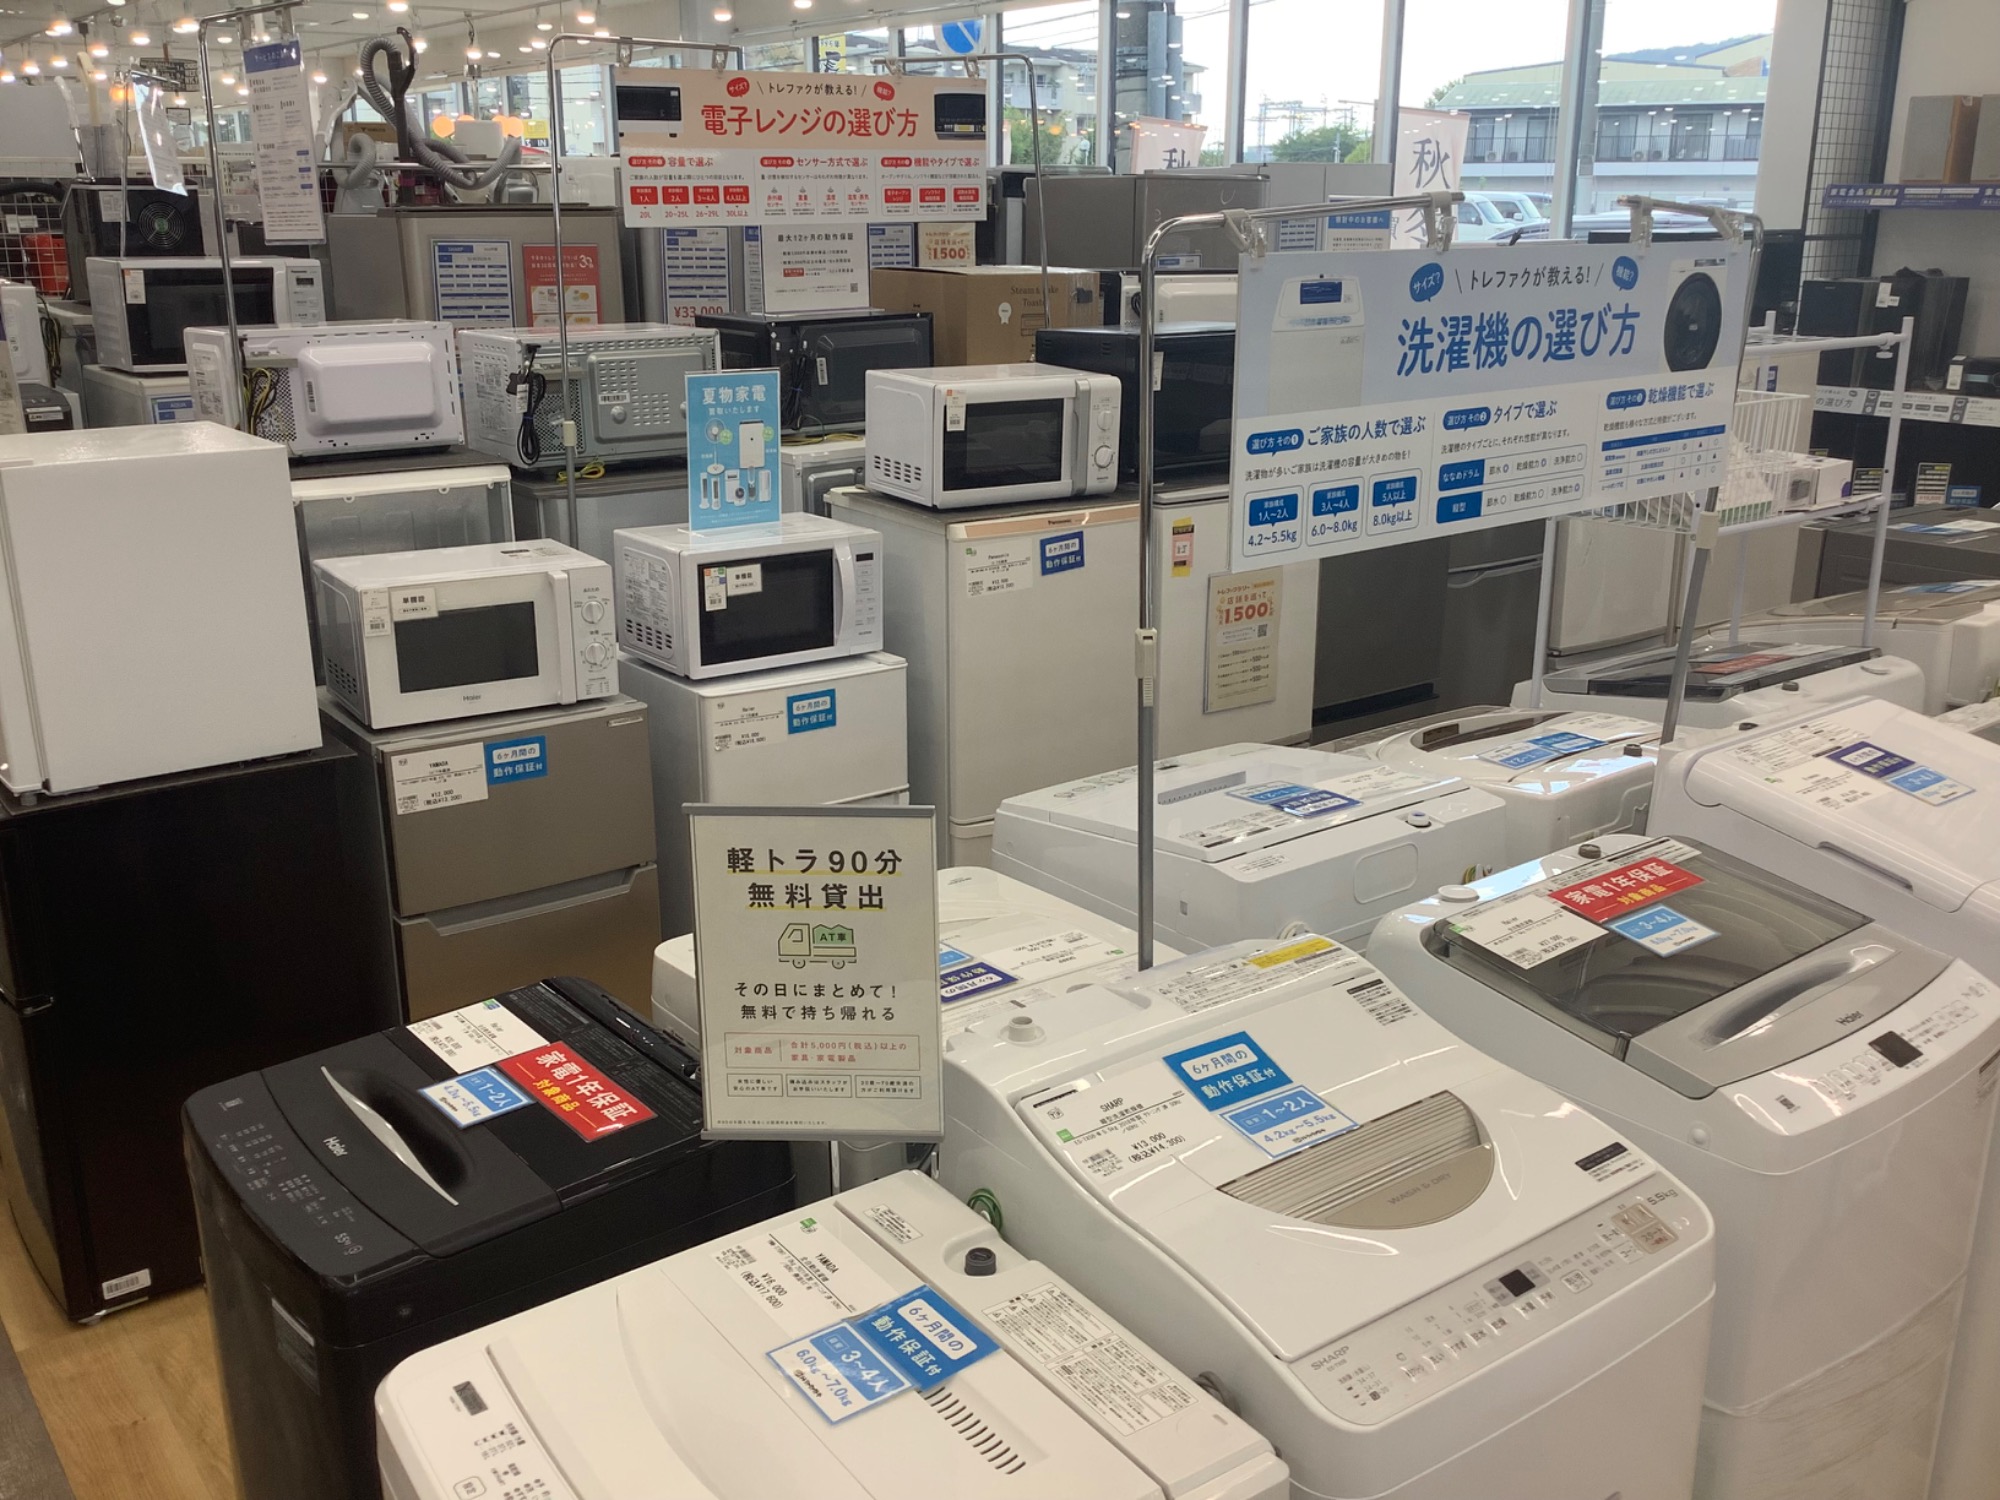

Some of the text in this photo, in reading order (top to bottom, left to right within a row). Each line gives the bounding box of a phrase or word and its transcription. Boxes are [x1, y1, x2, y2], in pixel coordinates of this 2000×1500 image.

[768, 82, 858, 96] トレファクが教える!
[700, 104, 920, 137] 電子レンジの選び方
[796, 157, 869, 167] センサー方式で選ぶ
[913, 157, 980, 167] 機能やタイプで選ぶ
[1409, 137, 1451, 189] 秋
[639, 211, 651, 219] 20L
[778, 233, 853, 242] 最大12ヶ月の動作保証
[1469, 262, 1591, 290] トレファクが教える!
[1614, 263, 1637, 280] 機能?
[1412, 274, 1442, 292] サイズ?
[1396, 302, 1641, 377] 洗濯機の選び方
[702, 384, 767, 405] 夏物家電
[1648, 382, 1715, 404] 乾燥機能で選ぶ
[708, 406, 760, 416] 買取いたします
[1493, 400, 1558, 425] タイプで選ぶ
[1307, 416, 1426, 446] ご家族の人数で選ぶ
[1442, 469, 1481, 483] ななめドラム
[1381, 490, 1407, 502] 5人以上
[1372, 509, 1413, 526] 8.0kg以上
[1248, 529, 1297, 547] 4.2～5.5kg
[1311, 519, 1358, 537] 6.0～8.0kg
[795, 699, 828, 712] 6ヶ月間の
[793, 714, 833, 727] 動作保証付
[496, 747, 536, 760] 6ヶ月間の
[493, 763, 543, 778] 動作保証付
[726, 848, 902, 875] 軽トラ90分
[1564, 861, 1675, 906] 家電1年保証
[747, 882, 885, 910] 無料貸出
[1616, 883, 1668, 906] 対象商品
[819, 932, 847, 943] AT車
[734, 982, 897, 999] その日にまとめて!
[740, 1004, 896, 1022] 無料で持ち帰れる
[734, 1046, 773, 1055] 対象商品
[790, 1040, 908, 1051] 合計5,000円(税込)以上の
[790, 1054, 857, 1063] 家具・家電製品
[1192, 1049, 1248, 1075] 6ヶ月間の
[535, 1051, 638, 1121] 家電1年保証
[1200, 1067, 1277, 1099] 動作保証付
[478, 1081, 513, 1112] 1～2人
[532, 1078, 581, 1113] 対象商品
[1099, 1097, 1124, 1113] SHARP
[1261, 1096, 1315, 1119] 1～2人
[1128, 1134, 1186, 1164] (税込¥14,300)
[1130, 1132, 1167, 1151] ¥13,000
[1387, 1185, 1421, 1206] WASH
[815, 1252, 839, 1275] YAMADA
[908, 1306, 965, 1353] 6ヶ月間の
[870, 1314, 943, 1377] 動作保証付
[1310, 1345, 1351, 1372] SHARP
[840, 1349, 890, 1393] 3～4人
